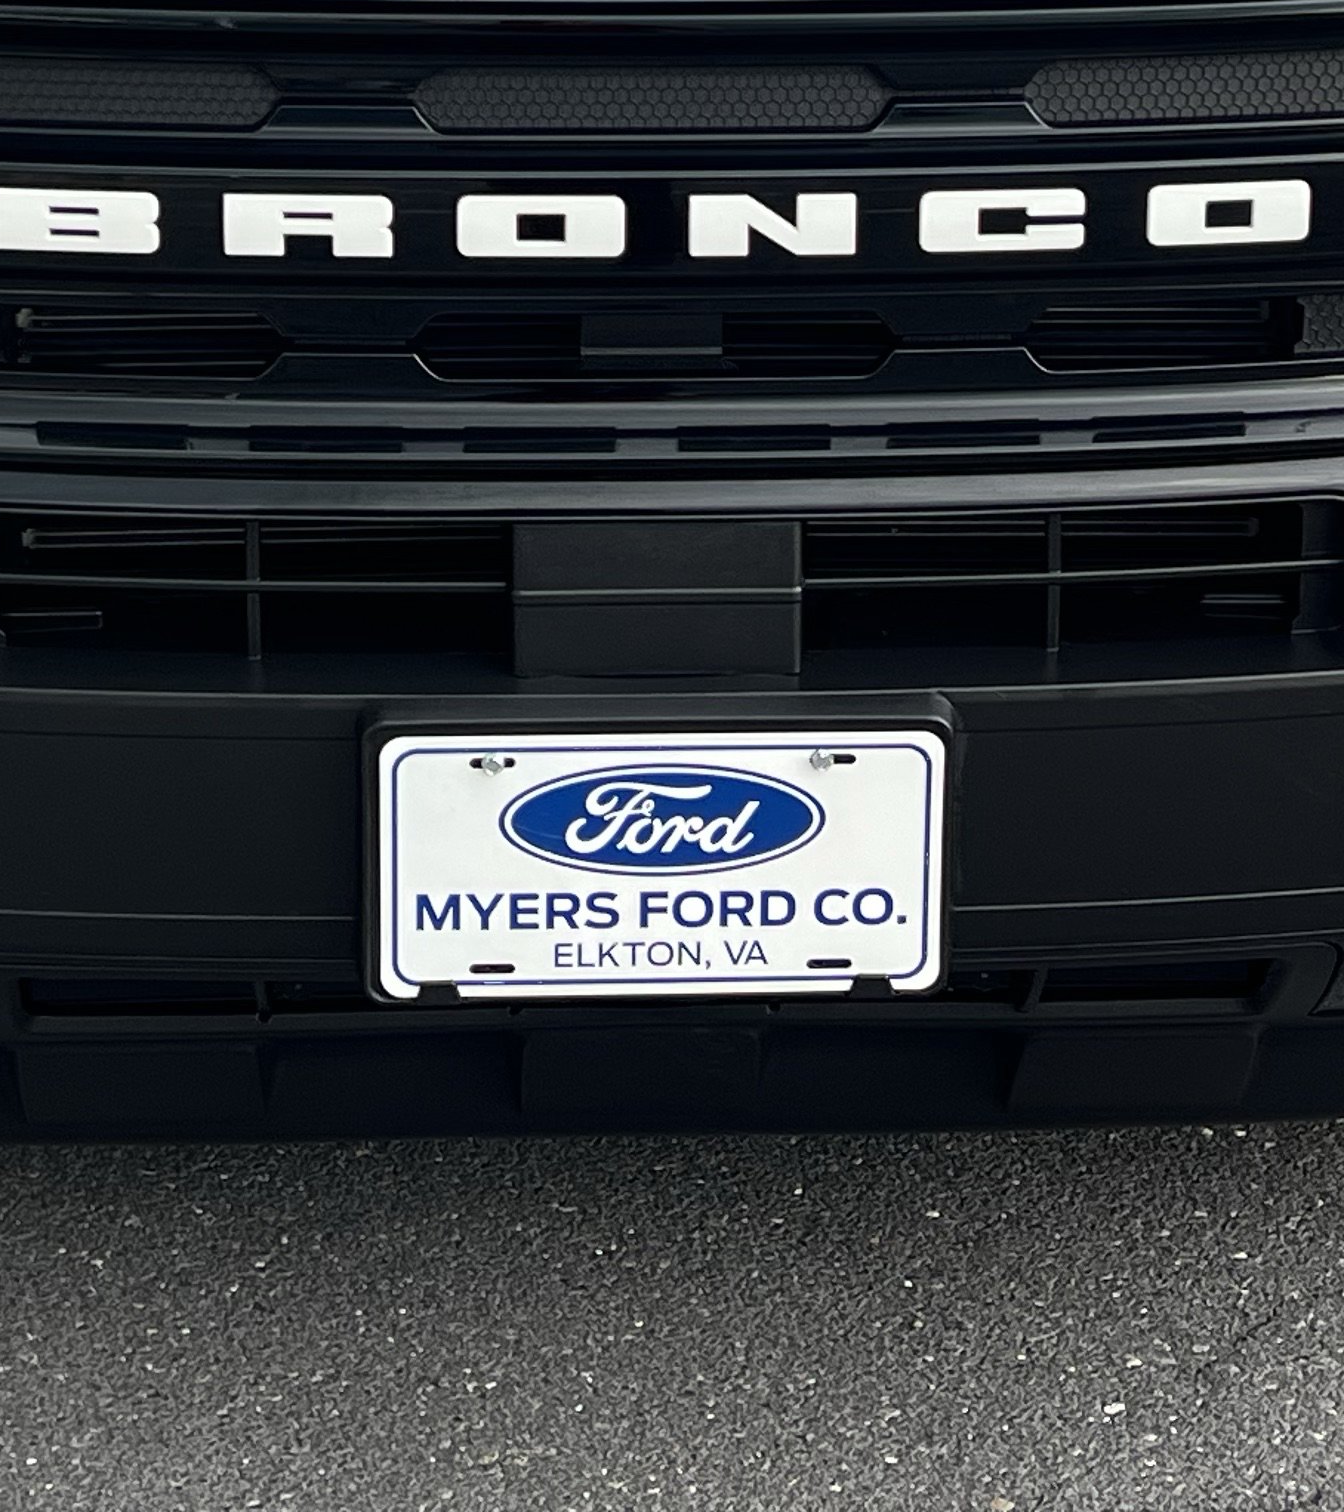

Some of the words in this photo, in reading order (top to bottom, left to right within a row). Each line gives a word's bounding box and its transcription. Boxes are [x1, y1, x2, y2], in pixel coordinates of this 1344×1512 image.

[564, 781, 760, 855] Ford
[416, 892, 620, 931] MYERS
[639, 890, 796, 928] FORD
[813, 888, 908, 926] CO.
[554, 941, 711, 969] ELKTON,
[724, 940, 769, 965] VA
